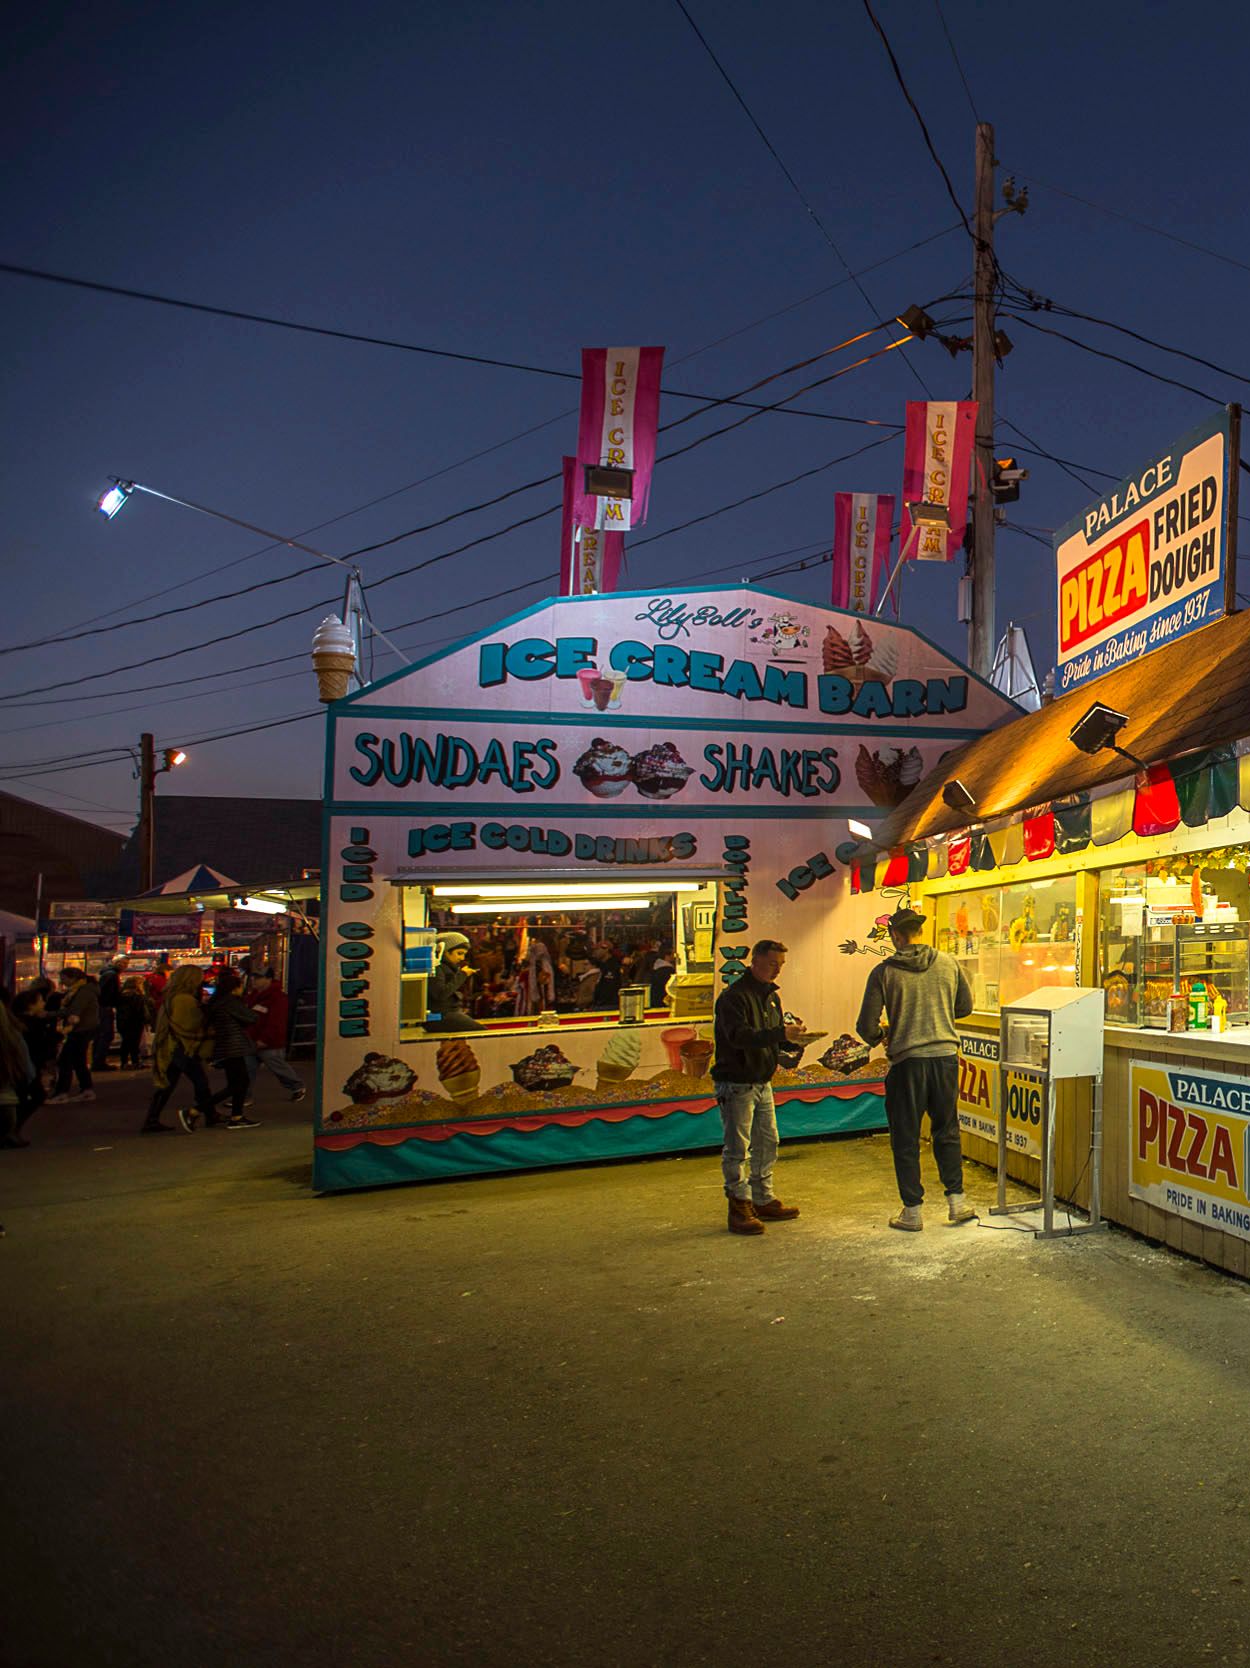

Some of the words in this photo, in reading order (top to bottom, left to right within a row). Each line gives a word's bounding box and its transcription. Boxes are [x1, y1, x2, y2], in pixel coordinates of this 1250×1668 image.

[610, 361, 627, 416] ICE
[931, 414, 947, 462] ICE
[604, 428, 626, 521] CRM
[1085, 455, 1173, 539] PALACE
[855, 507, 869, 549] ICE
[1153, 475, 1218, 551] FRIED
[854, 556, 866, 612] CREA
[1062, 531, 1147, 644] PIZZA
[1149, 527, 1216, 604] DOUGH
[635, 598, 694, 640] Lily
[1061, 659, 1092, 689] Pride
[1093, 648, 1104, 671] in
[1104, 630, 1147, 667] Baking
[1150, 611, 1182, 643] since
[1183, 589, 1210, 627] 1937
[479, 637, 598, 689] ICE
[609, 640, 808, 709] CREAM
[817, 674, 969, 719] BARN
[350, 732, 561, 794] SUNDAES
[700, 742, 841, 797] SHAKES
[340, 827, 378, 903] ICED
[408, 822, 476, 858] ICE
[480, 822, 573, 857] COLD
[575, 832, 698, 864] DRINKS
[776, 851, 837, 902] ICE
[336, 921, 375, 1038] COFFEE
[963, 1039, 997, 1059] PALACE
[1138, 1088, 1239, 1189] PIZZA
[1166, 1188, 1193, 1211] PRIDE
[1197, 1199, 1206, 1216] IN
[1211, 1205, 1250, 1232] BAKING
